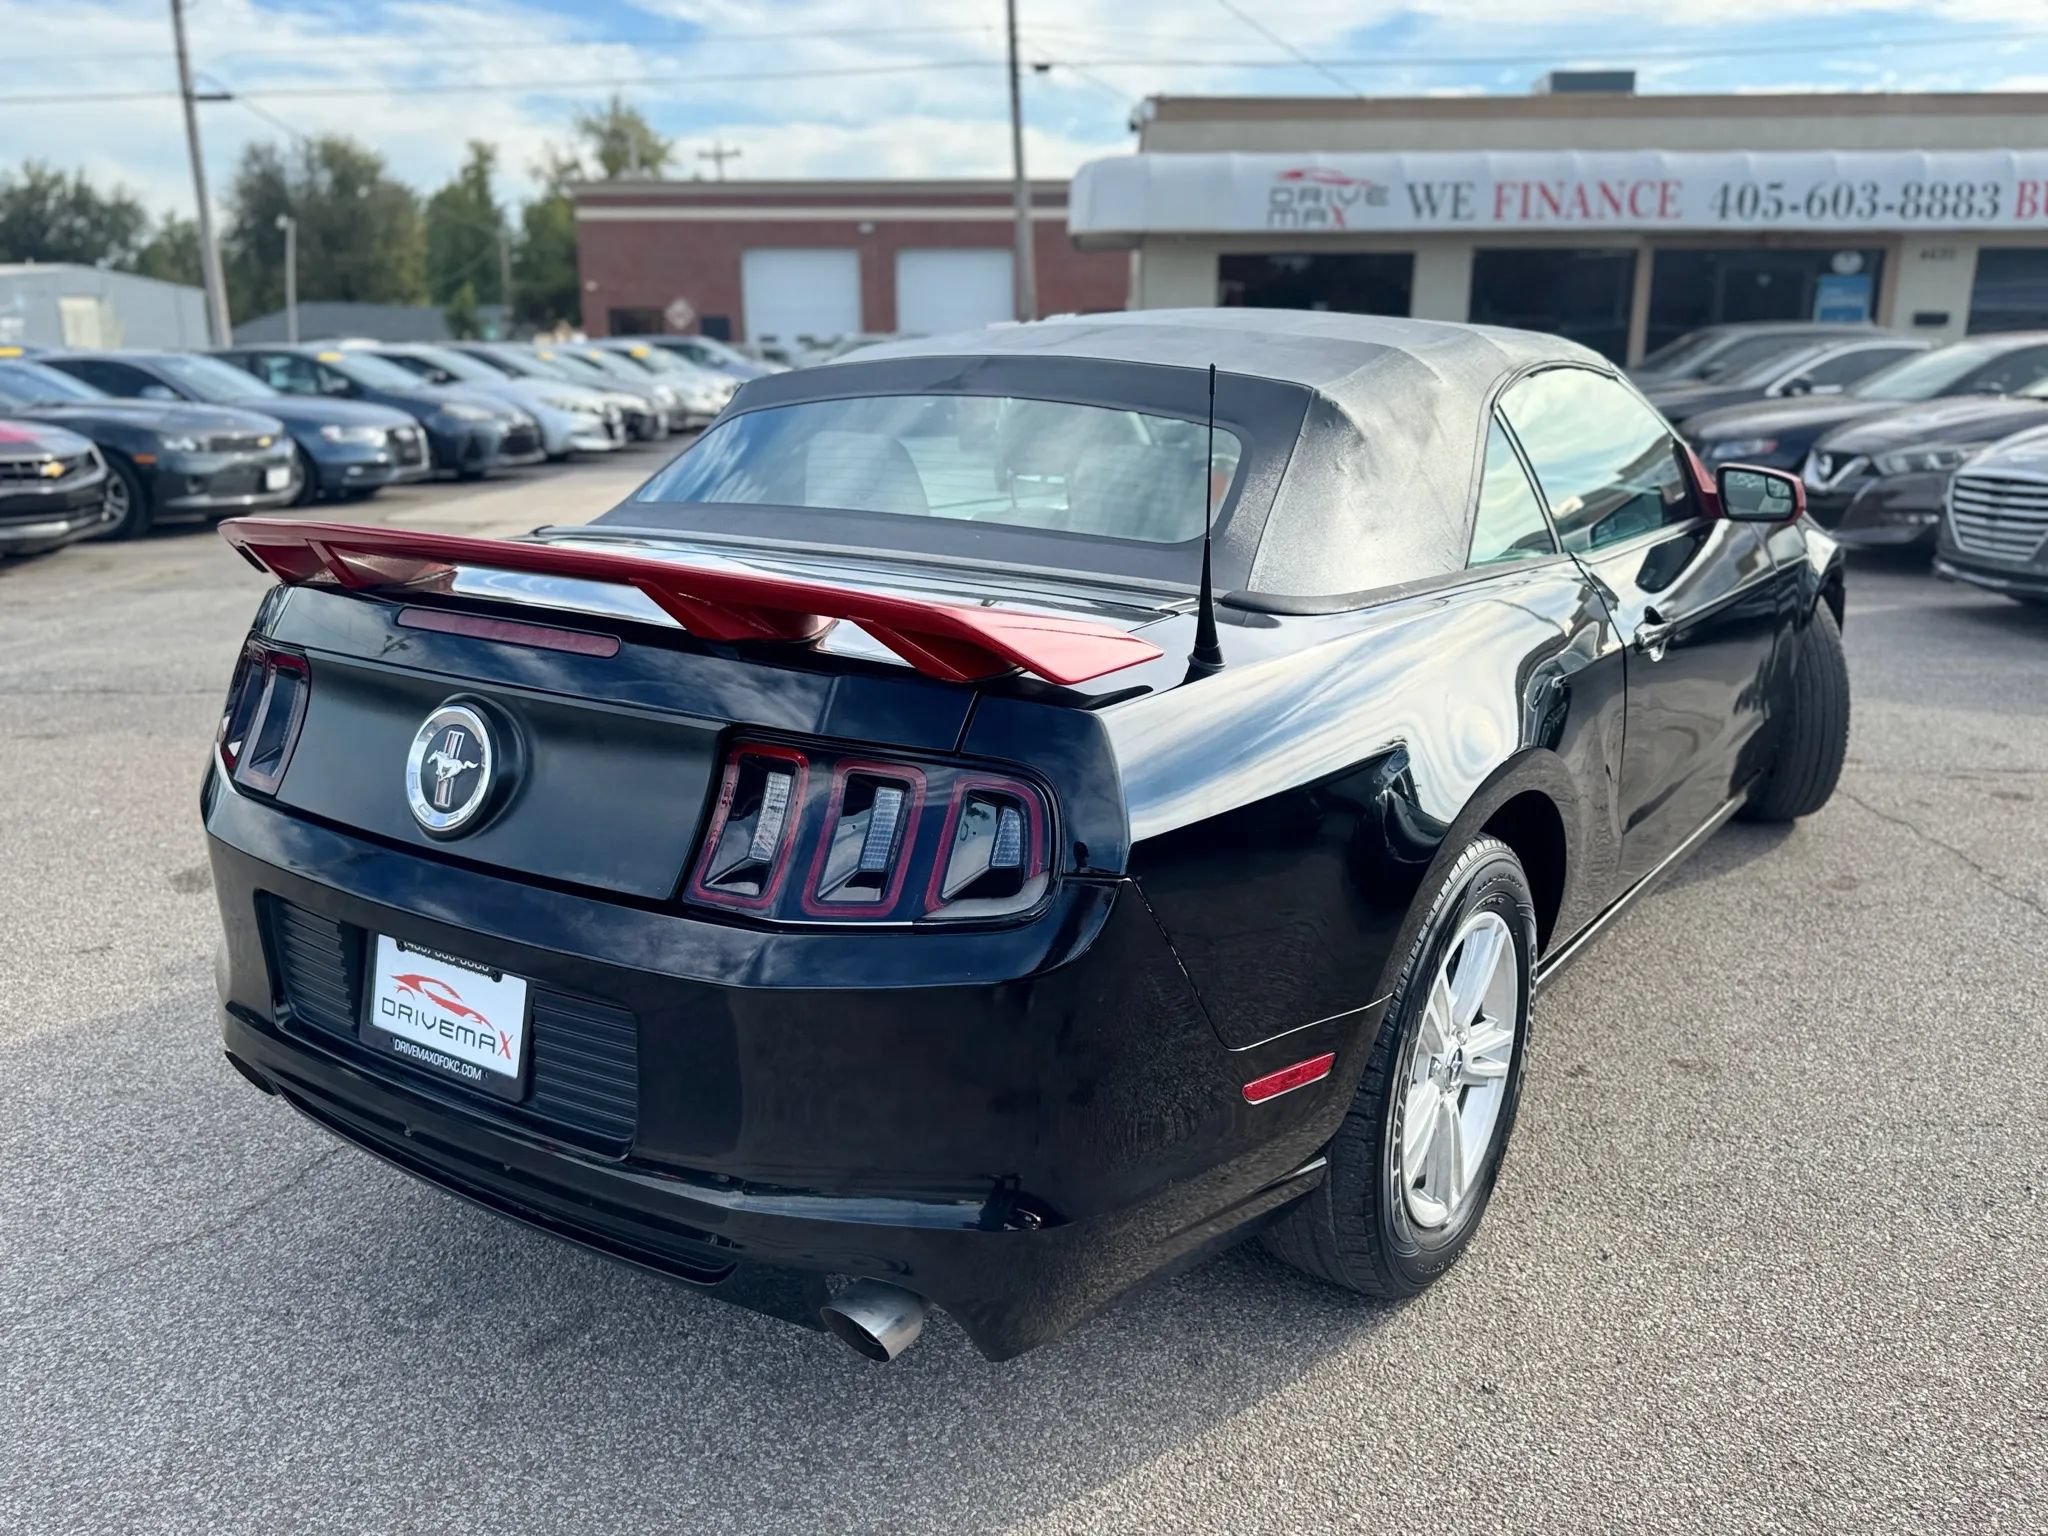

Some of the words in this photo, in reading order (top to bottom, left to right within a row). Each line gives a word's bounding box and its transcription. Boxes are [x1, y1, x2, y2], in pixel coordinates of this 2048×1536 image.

[1267, 203, 1346, 231] MAX
[1269, 184, 1391, 208] DRIVE
[1406, 181, 1476, 221] WE
[1493, 180, 1683, 221] FINANCE
[1710, 180, 2001, 221] 405-603-8883
[2014, 179, 2048, 221] B
[382, 997, 514, 1060] DRIVEMAX
[394, 1038, 482, 1080] DRIVEMAXOFOKC.COM
